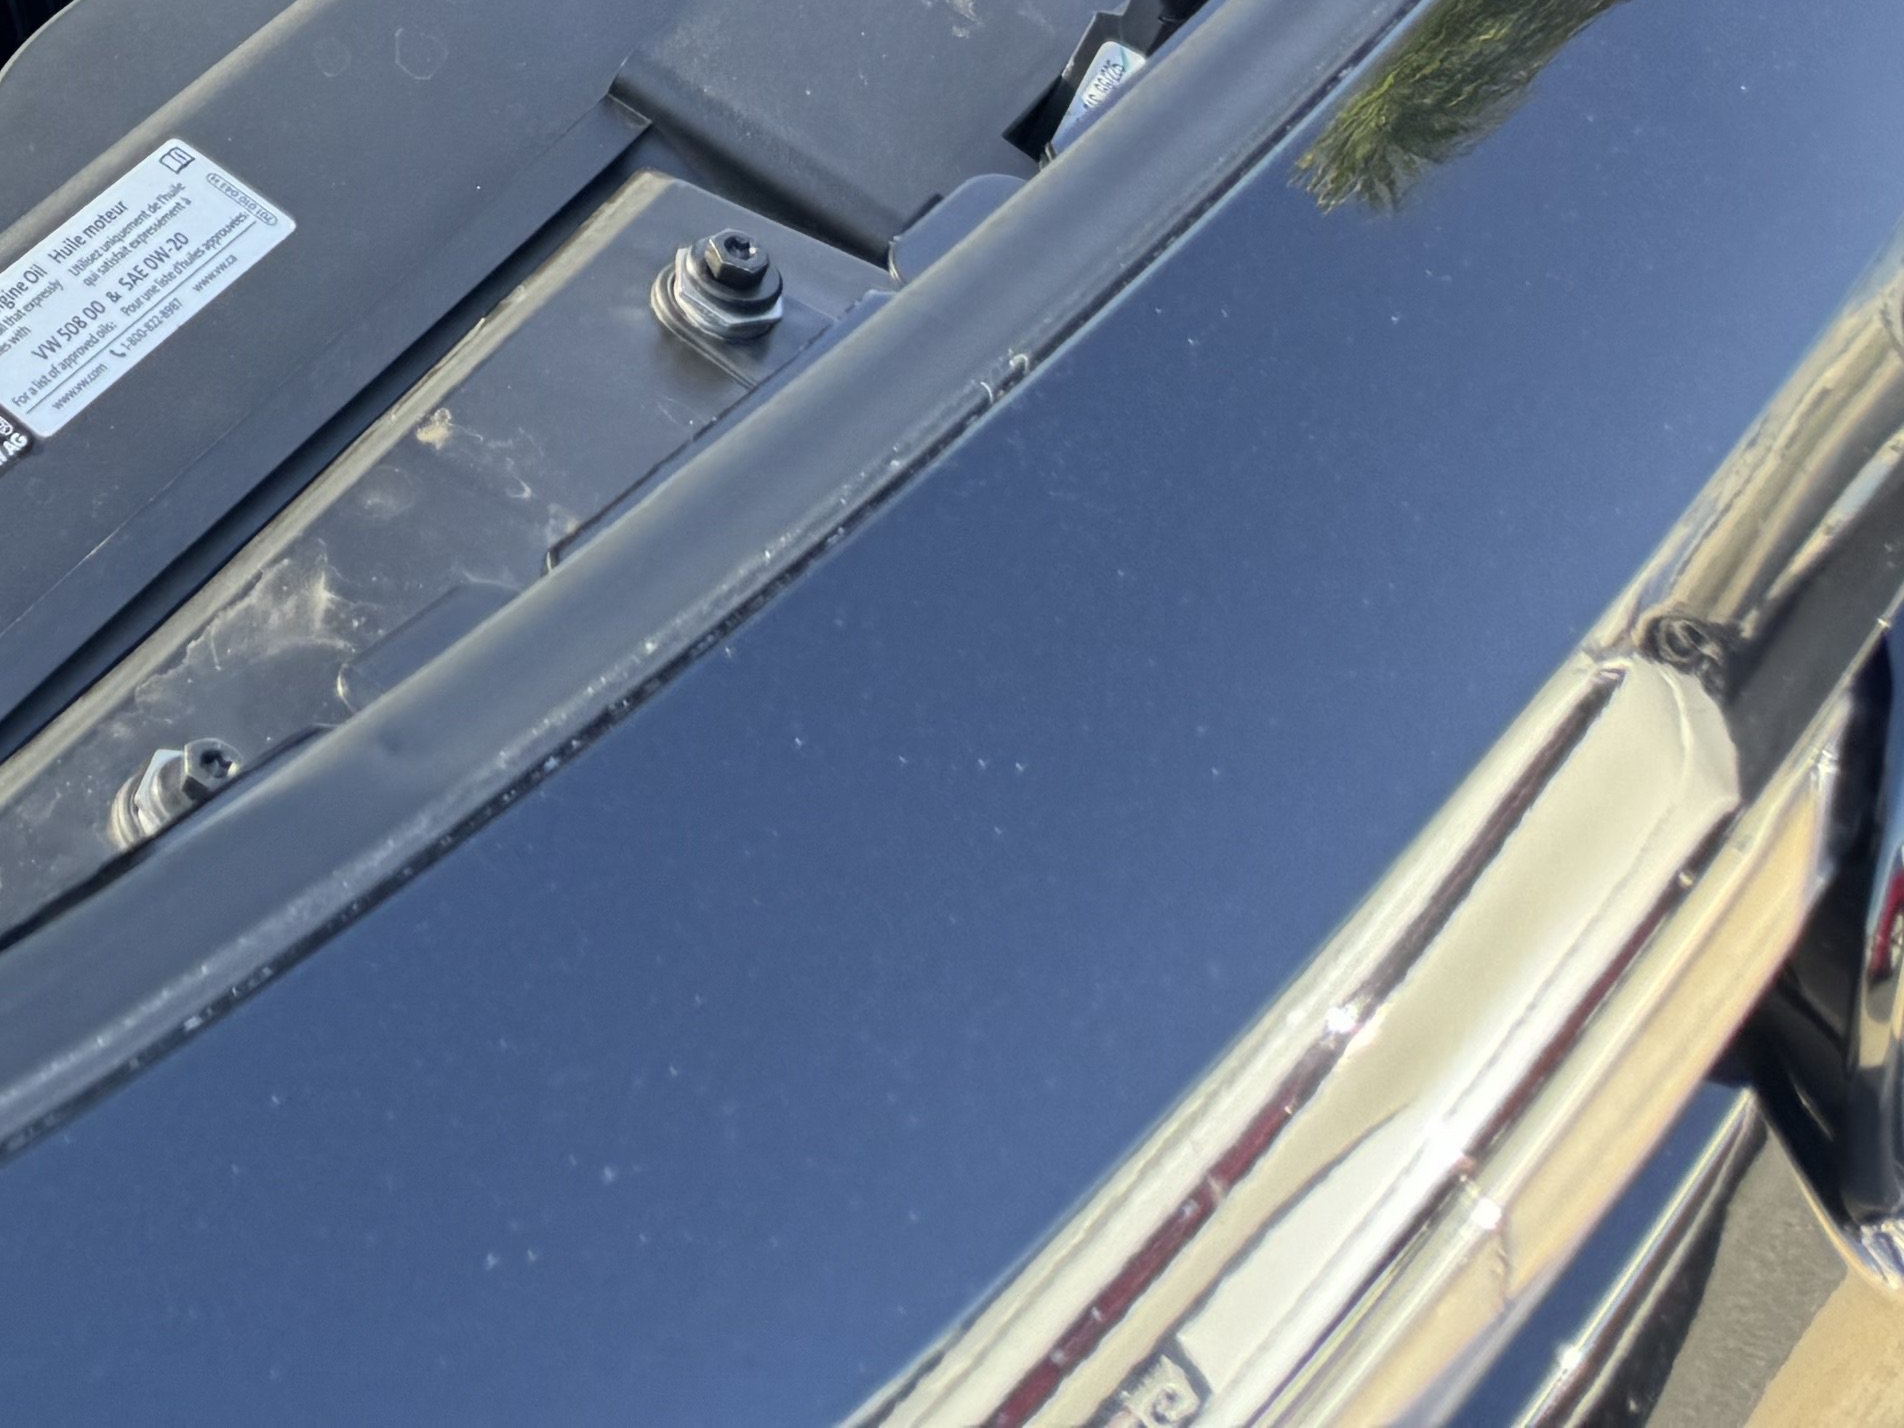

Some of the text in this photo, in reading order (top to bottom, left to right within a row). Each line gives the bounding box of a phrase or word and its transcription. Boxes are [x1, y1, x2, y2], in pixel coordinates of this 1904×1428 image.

[47, 200, 127, 263] Huile moteur
[67, 249, 103, 276] Utilisez
[99, 209, 151, 252] uniquement
[147, 201, 161, 213] de
[82, 271, 100, 286] qui
[96, 245, 132, 275] satisfait
[128, 201, 185, 249] expressément
[2, 308, 26, 327] that
[22, 279, 63, 312] expressly
[22, 263, 47, 284] Oil
[31, 231, 188, 360] VW 508 00 & SAE 0W-20
[119, 296, 144, 316] Pour
[140, 284, 160, 301] une
[153, 271, 177, 288] liste
[7, 326, 31, 344] with
[52, 363, 107, 409] www.vw.com
[192, 254, 237, 291] www.vw.ca
[11, 321, 117, 407] For a list of approved oils:
[3, 432, 27, 455] AG
